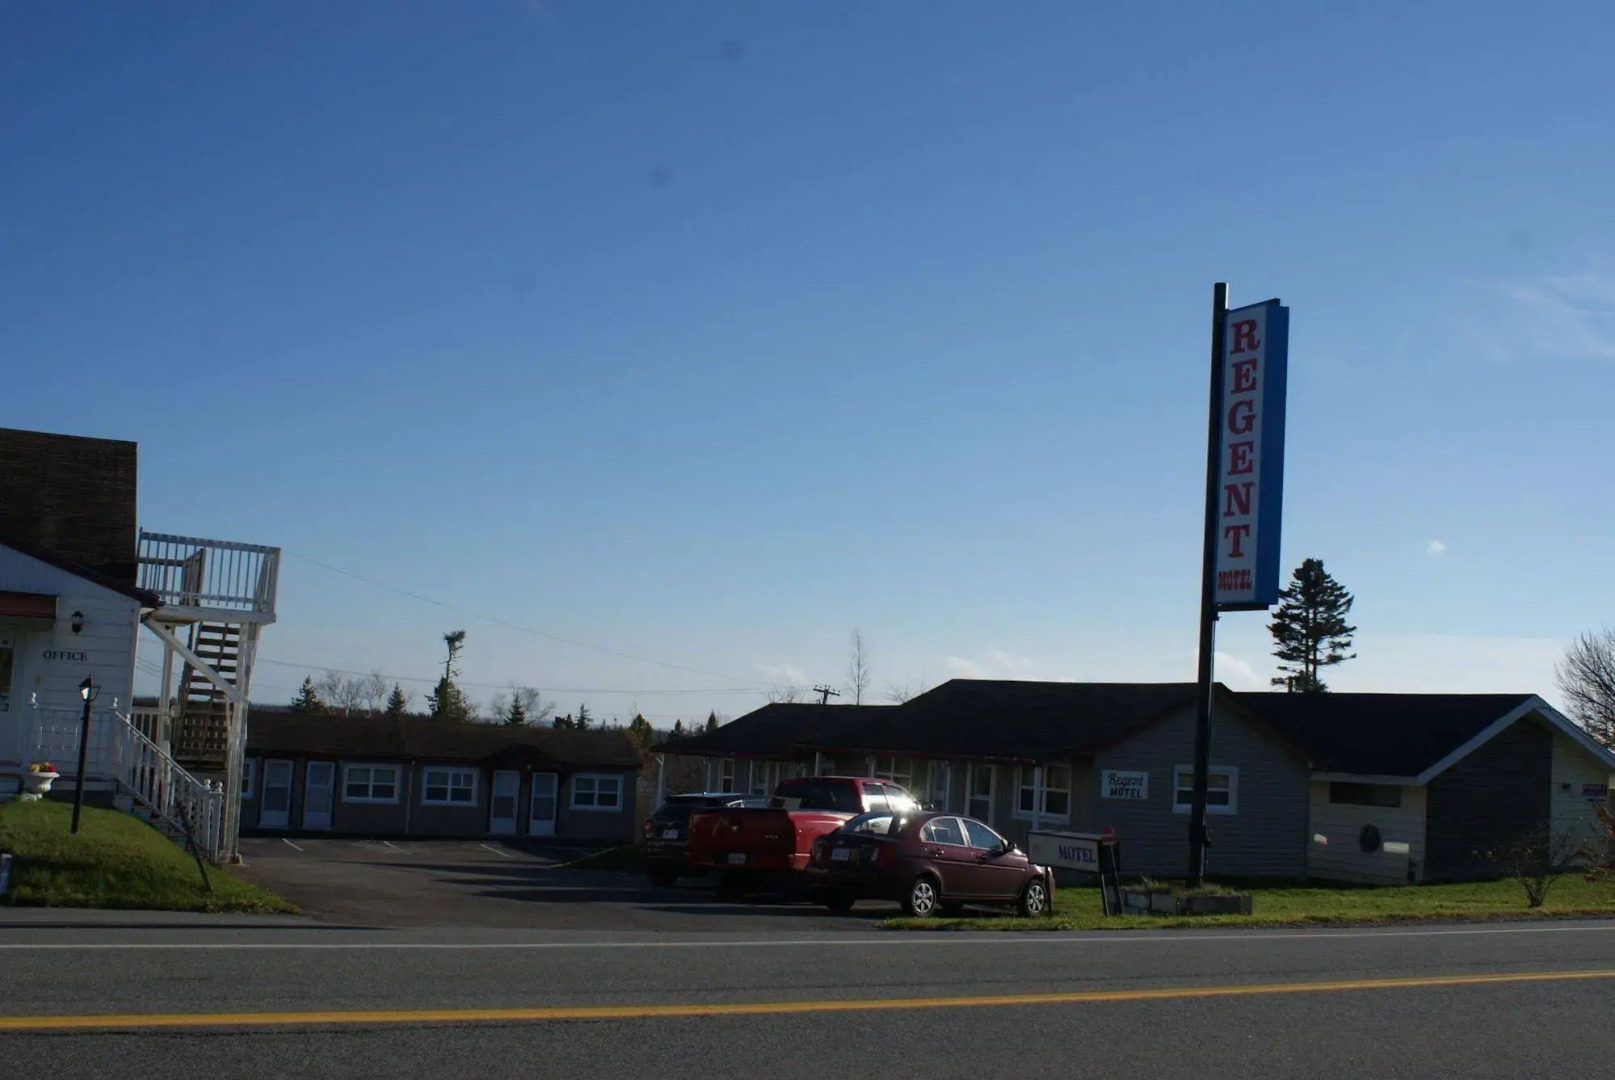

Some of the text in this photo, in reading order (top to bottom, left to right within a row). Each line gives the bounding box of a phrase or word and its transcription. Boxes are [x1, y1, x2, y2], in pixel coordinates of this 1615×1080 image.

[1223, 318, 1260, 558] REGENT
[1218, 569, 1252, 590] MOTEL
[43, 650, 87, 661] OFFICE
[1110, 787, 1142, 798] MOTEL
[1058, 845, 1096, 863] MOTEL
